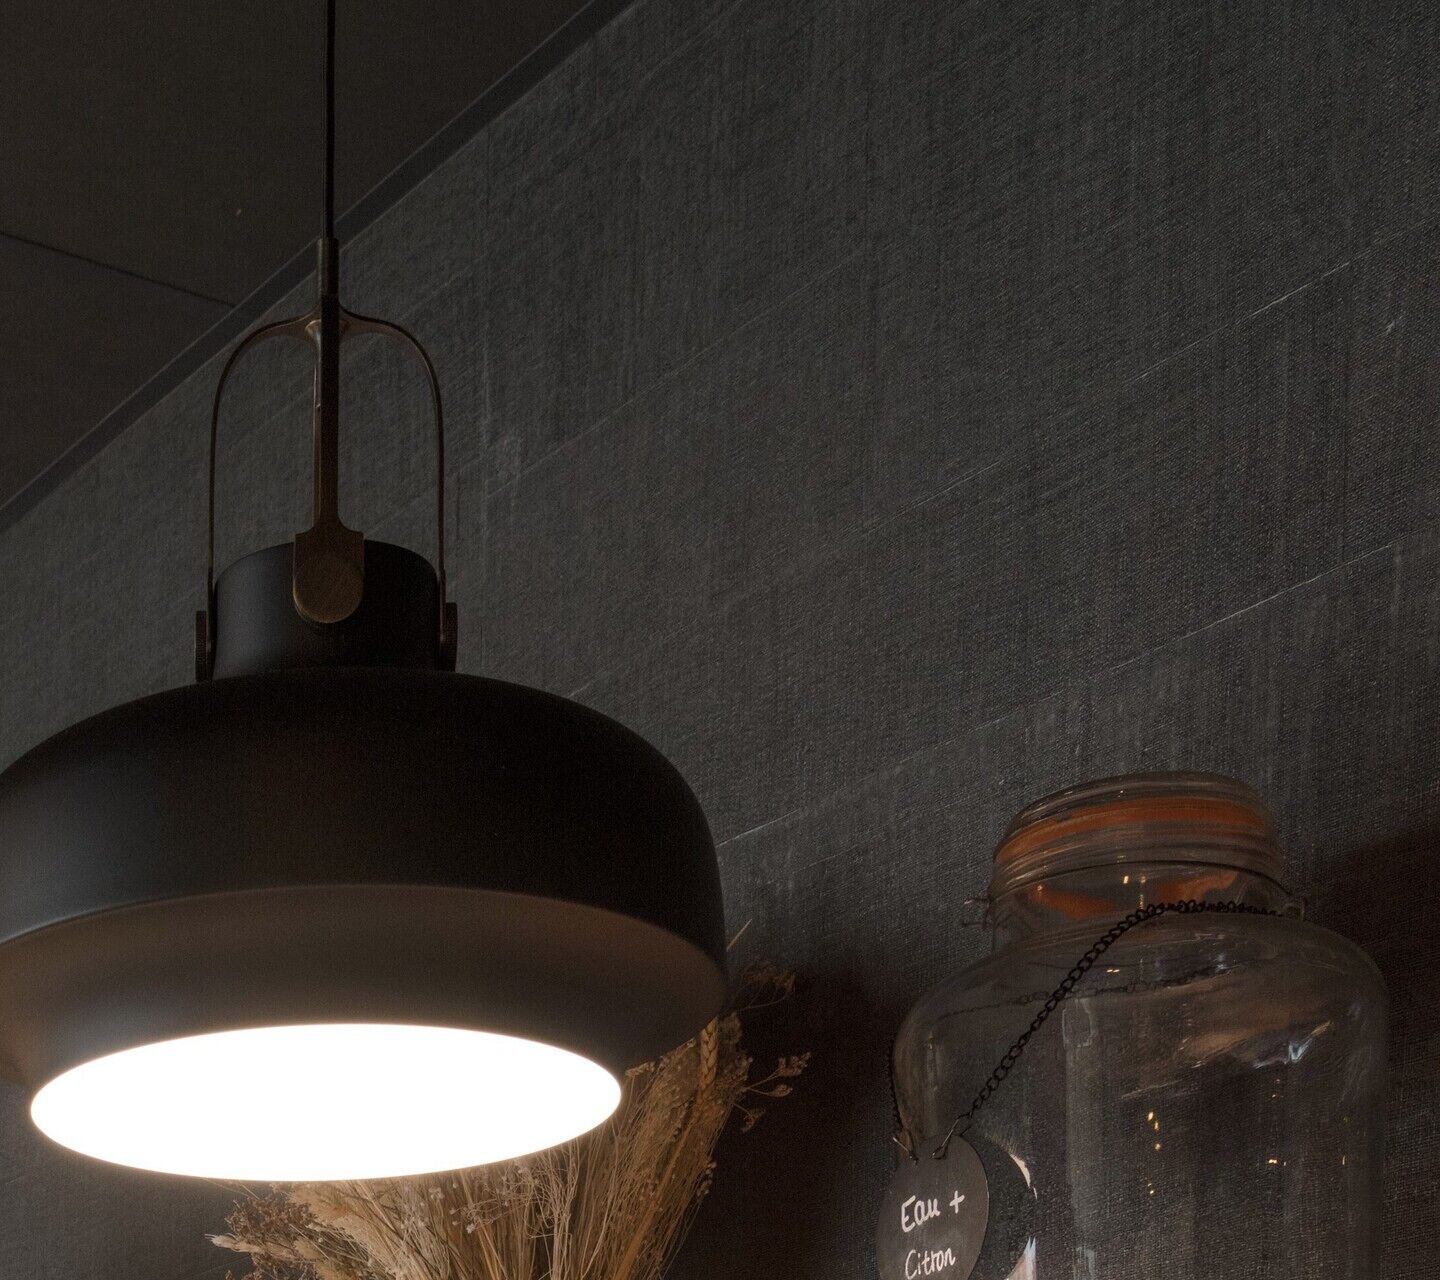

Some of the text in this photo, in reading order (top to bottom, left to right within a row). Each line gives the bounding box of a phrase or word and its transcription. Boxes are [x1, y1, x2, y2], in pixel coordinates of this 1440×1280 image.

[901, 1190, 965, 1233] Eau +
[905, 1247, 956, 1280] Citron
